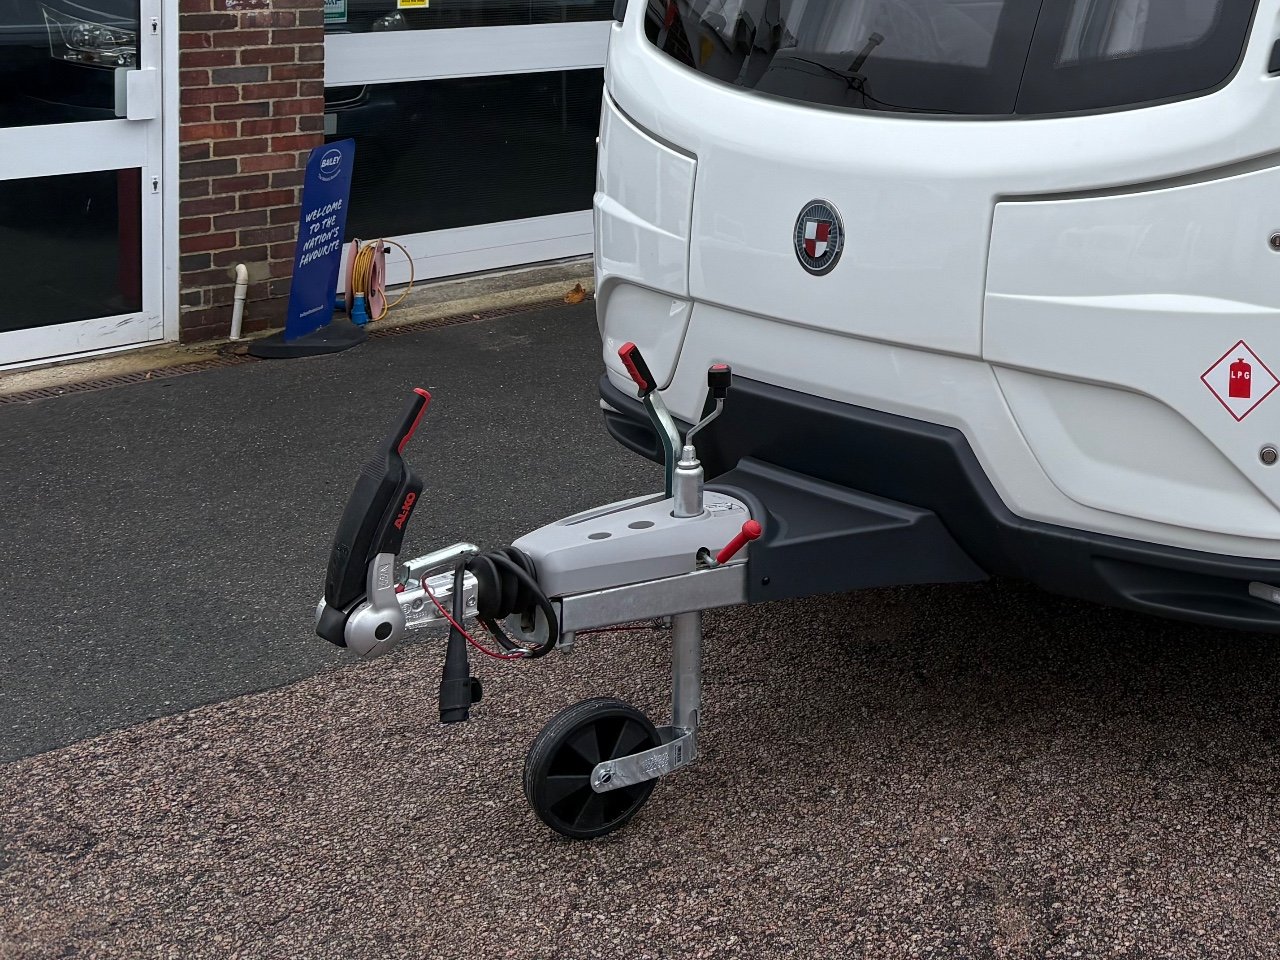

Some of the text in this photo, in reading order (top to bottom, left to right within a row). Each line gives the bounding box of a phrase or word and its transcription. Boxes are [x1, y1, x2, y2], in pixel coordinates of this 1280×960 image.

[305, 199, 342, 223] WELCOME
[309, 215, 337, 235] TO THE
[299, 239, 340, 269] FAVOURITE
[1231, 370, 1250, 380] LPG
